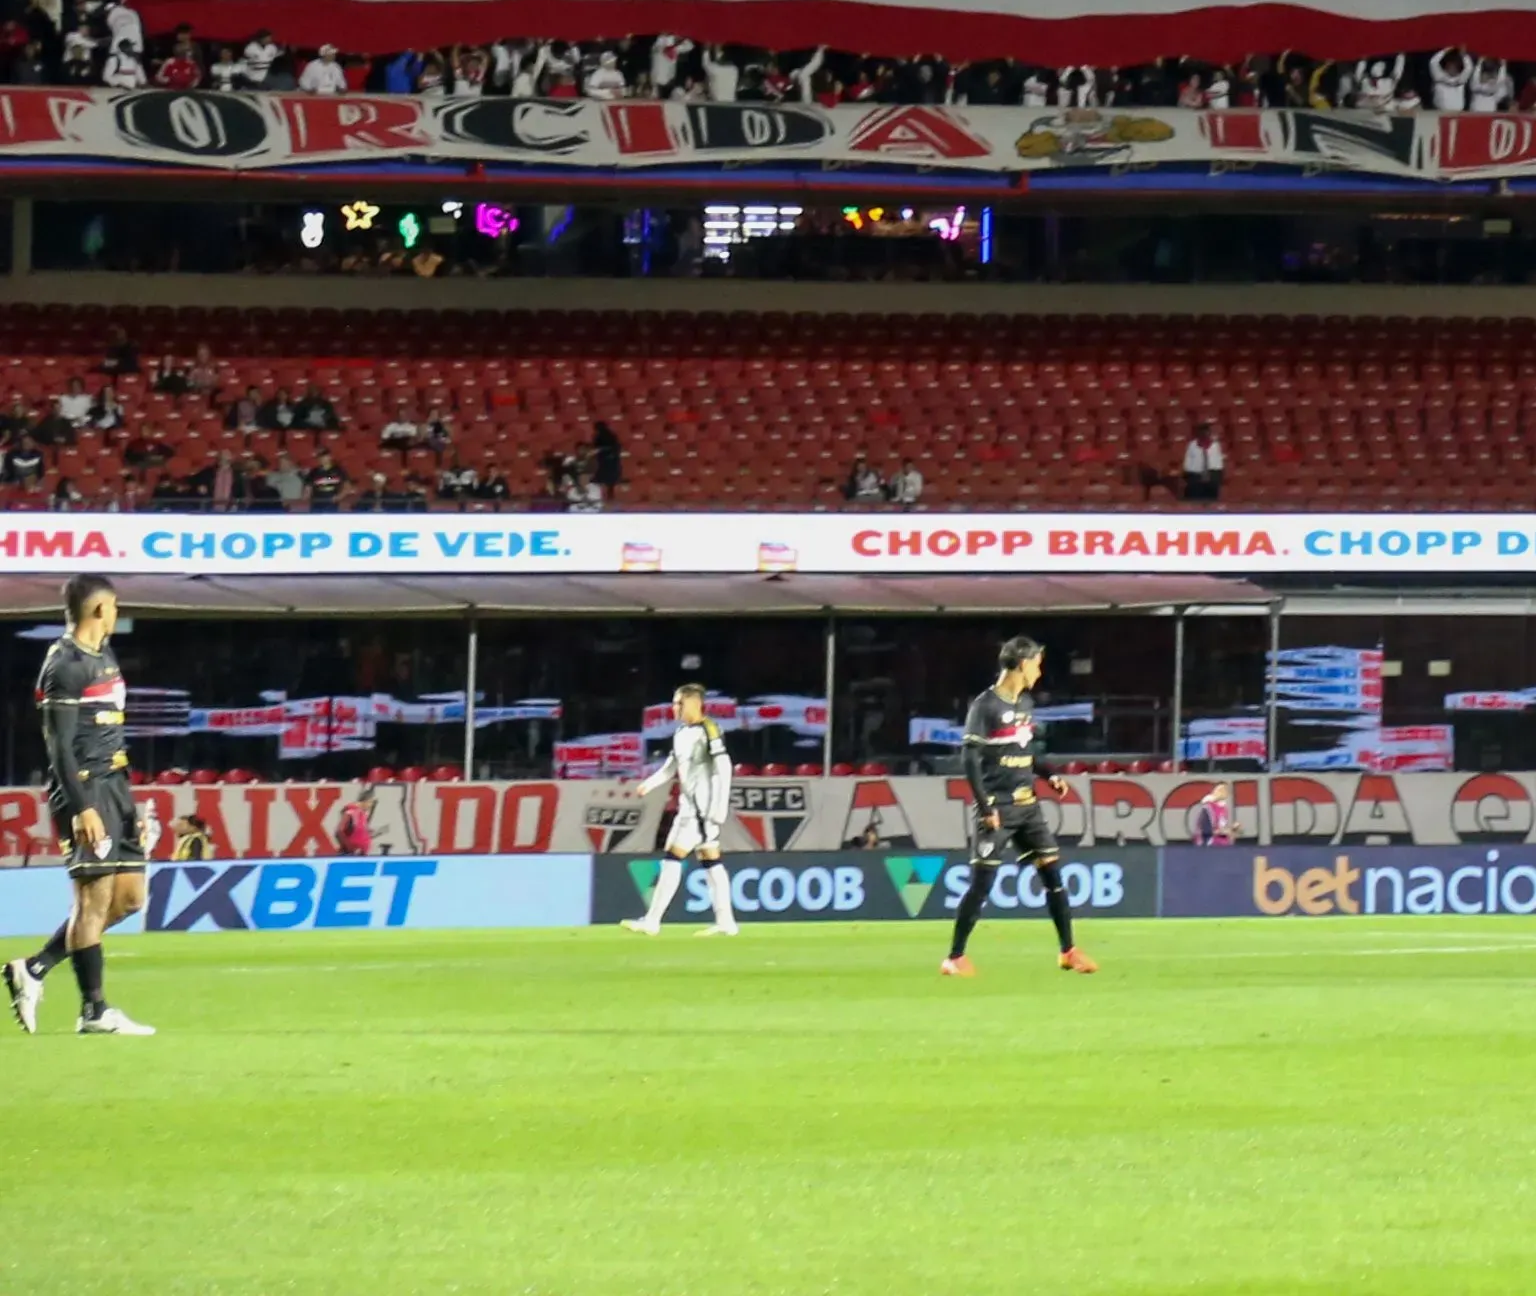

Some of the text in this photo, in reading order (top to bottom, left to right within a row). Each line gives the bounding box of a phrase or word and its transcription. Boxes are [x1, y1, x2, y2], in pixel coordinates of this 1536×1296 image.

[0, 87, 990, 159] TORCIDA
[142, 531, 333, 558] CHOPP
[348, 531, 418, 557] DE
[852, 530, 1032, 556] CHOPP
[1048, 530, 1291, 556] BRAHMA.
[1304, 530, 1481, 556] CHOPP
[685, 866, 865, 913] SCOOB
[943, 862, 1124, 910] SCOOB
